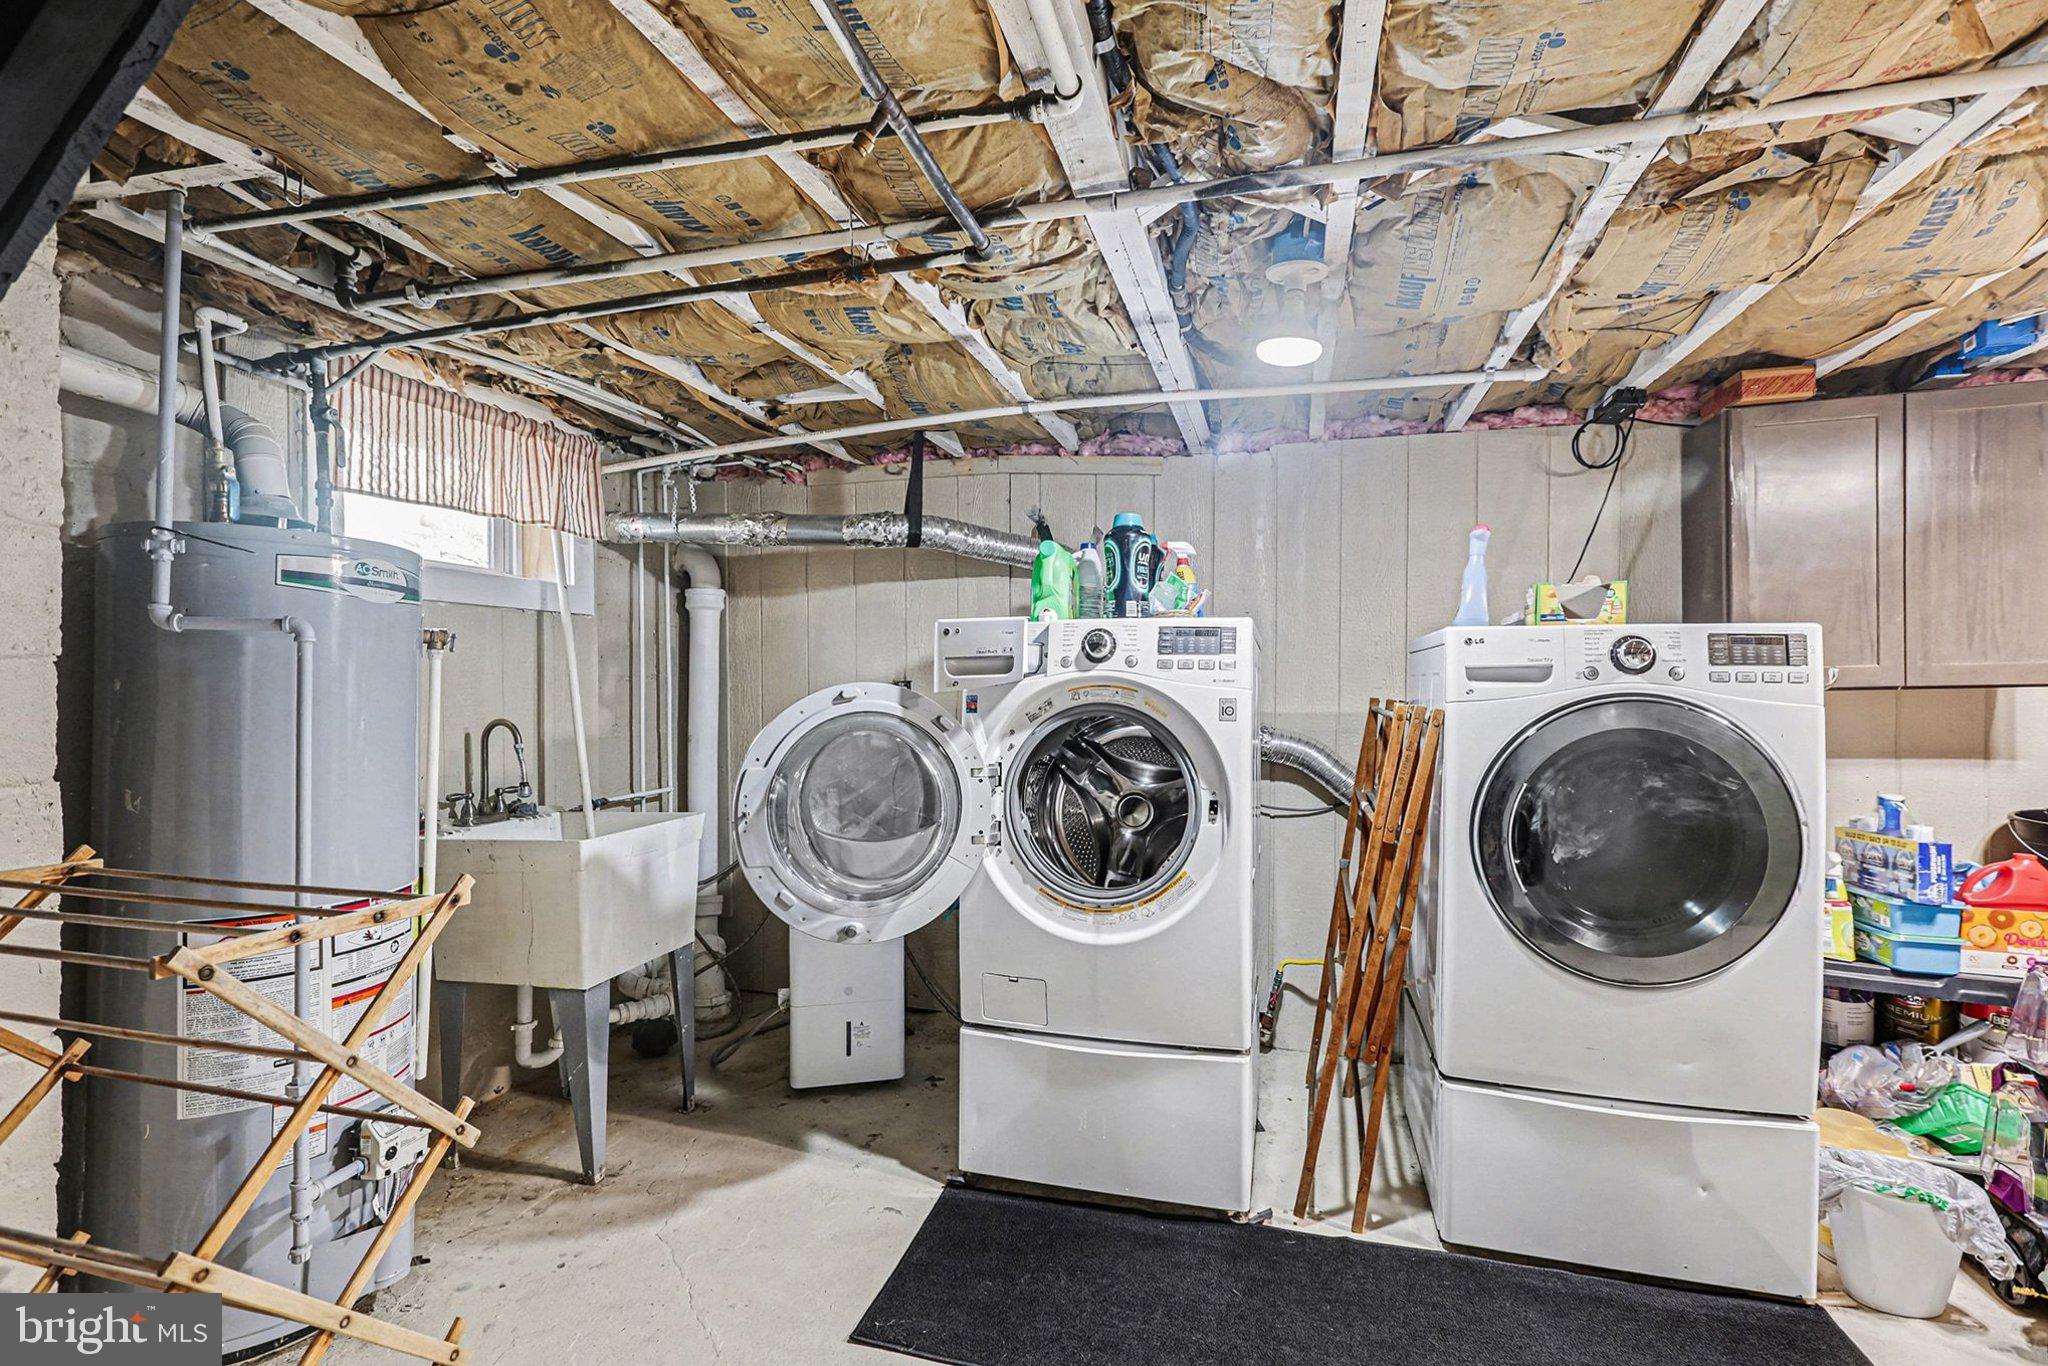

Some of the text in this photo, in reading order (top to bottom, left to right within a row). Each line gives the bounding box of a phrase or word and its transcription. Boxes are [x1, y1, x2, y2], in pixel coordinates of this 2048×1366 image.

[480, 23, 511, 53] ECOSE
[1385, 274, 1437, 311] KNAUF
[371, 566, 399, 580] Smith
